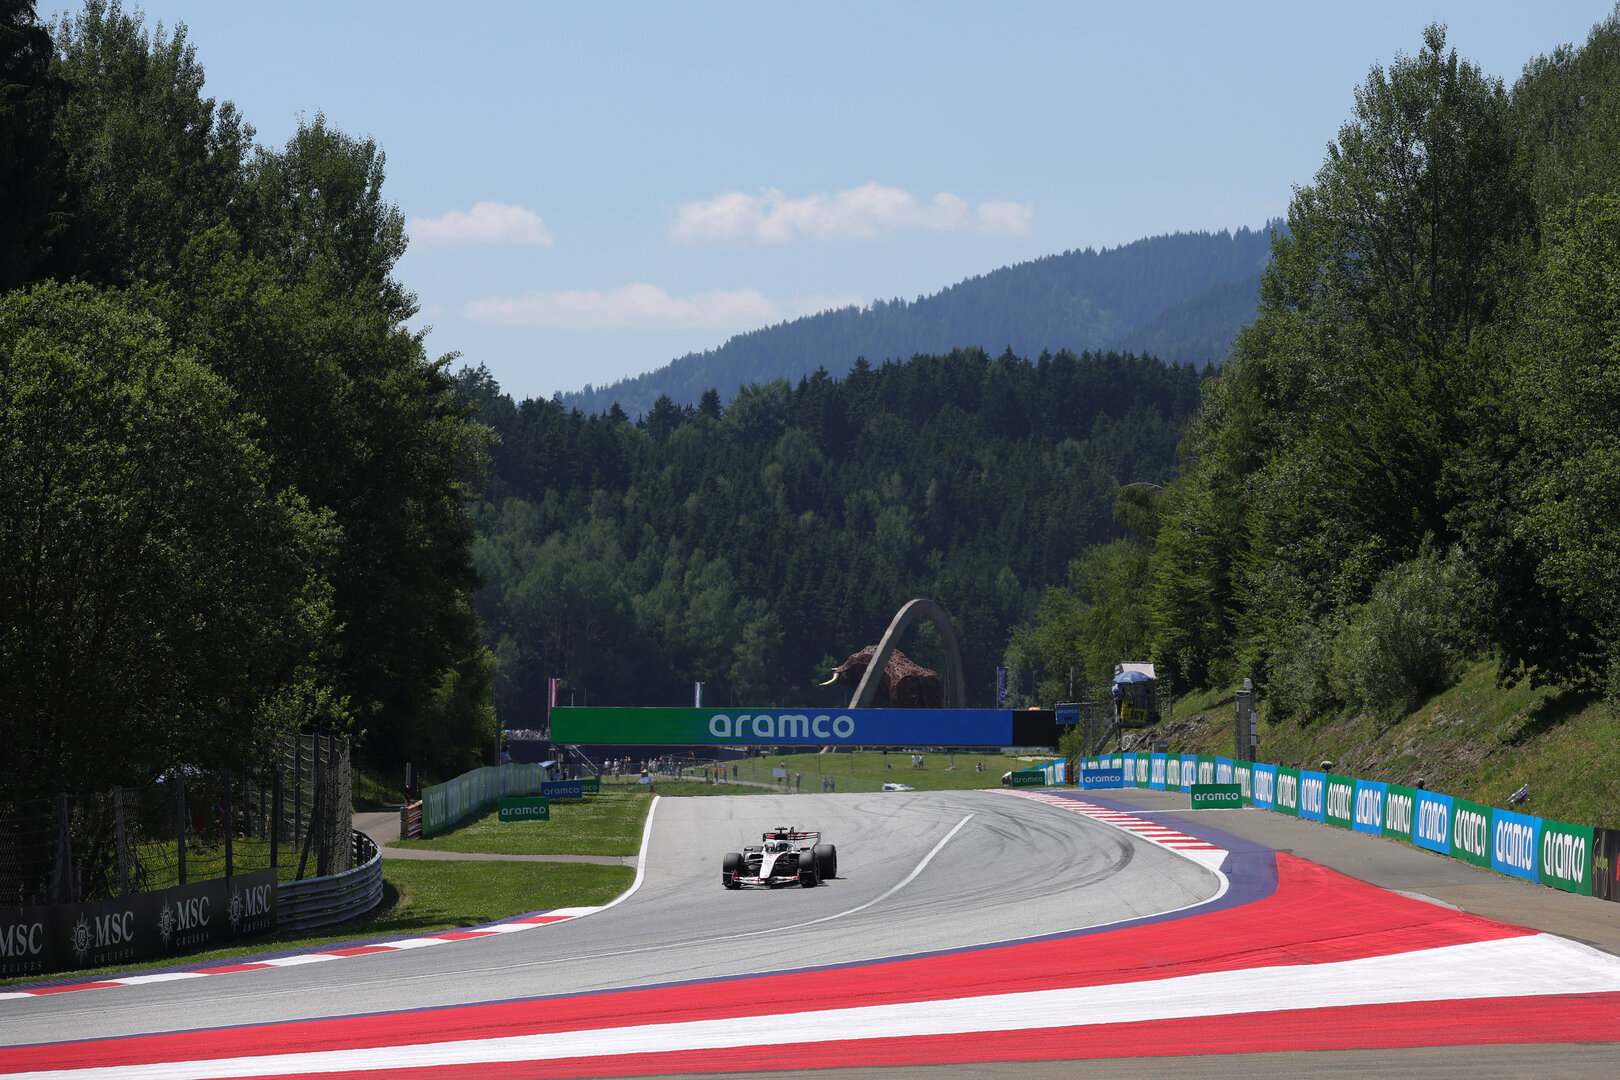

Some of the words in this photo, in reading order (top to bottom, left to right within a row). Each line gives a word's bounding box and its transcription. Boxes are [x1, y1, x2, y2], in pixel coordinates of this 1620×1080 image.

[708, 714, 855, 738] aramco
[543, 787, 580, 796] aramco
[1085, 775, 1121, 783] aramco
[501, 805, 547, 816] aramco
[1194, 792, 1239, 801] aramco
[1418, 799, 1447, 845] aramco
[1454, 808, 1487, 858] aramco
[1496, 819, 1533, 871] aramco
[1543, 830, 1585, 884] aramco
[176, 895, 210, 931] MSC
[244, 883, 272, 917] MSC
[0, 922, 43, 957] MSC
[94, 910, 134, 948] MSC
[176, 932, 209, 947] CRUISES
[0, 961, 43, 974] RUISES
[94, 947, 134, 965] CRUISES
